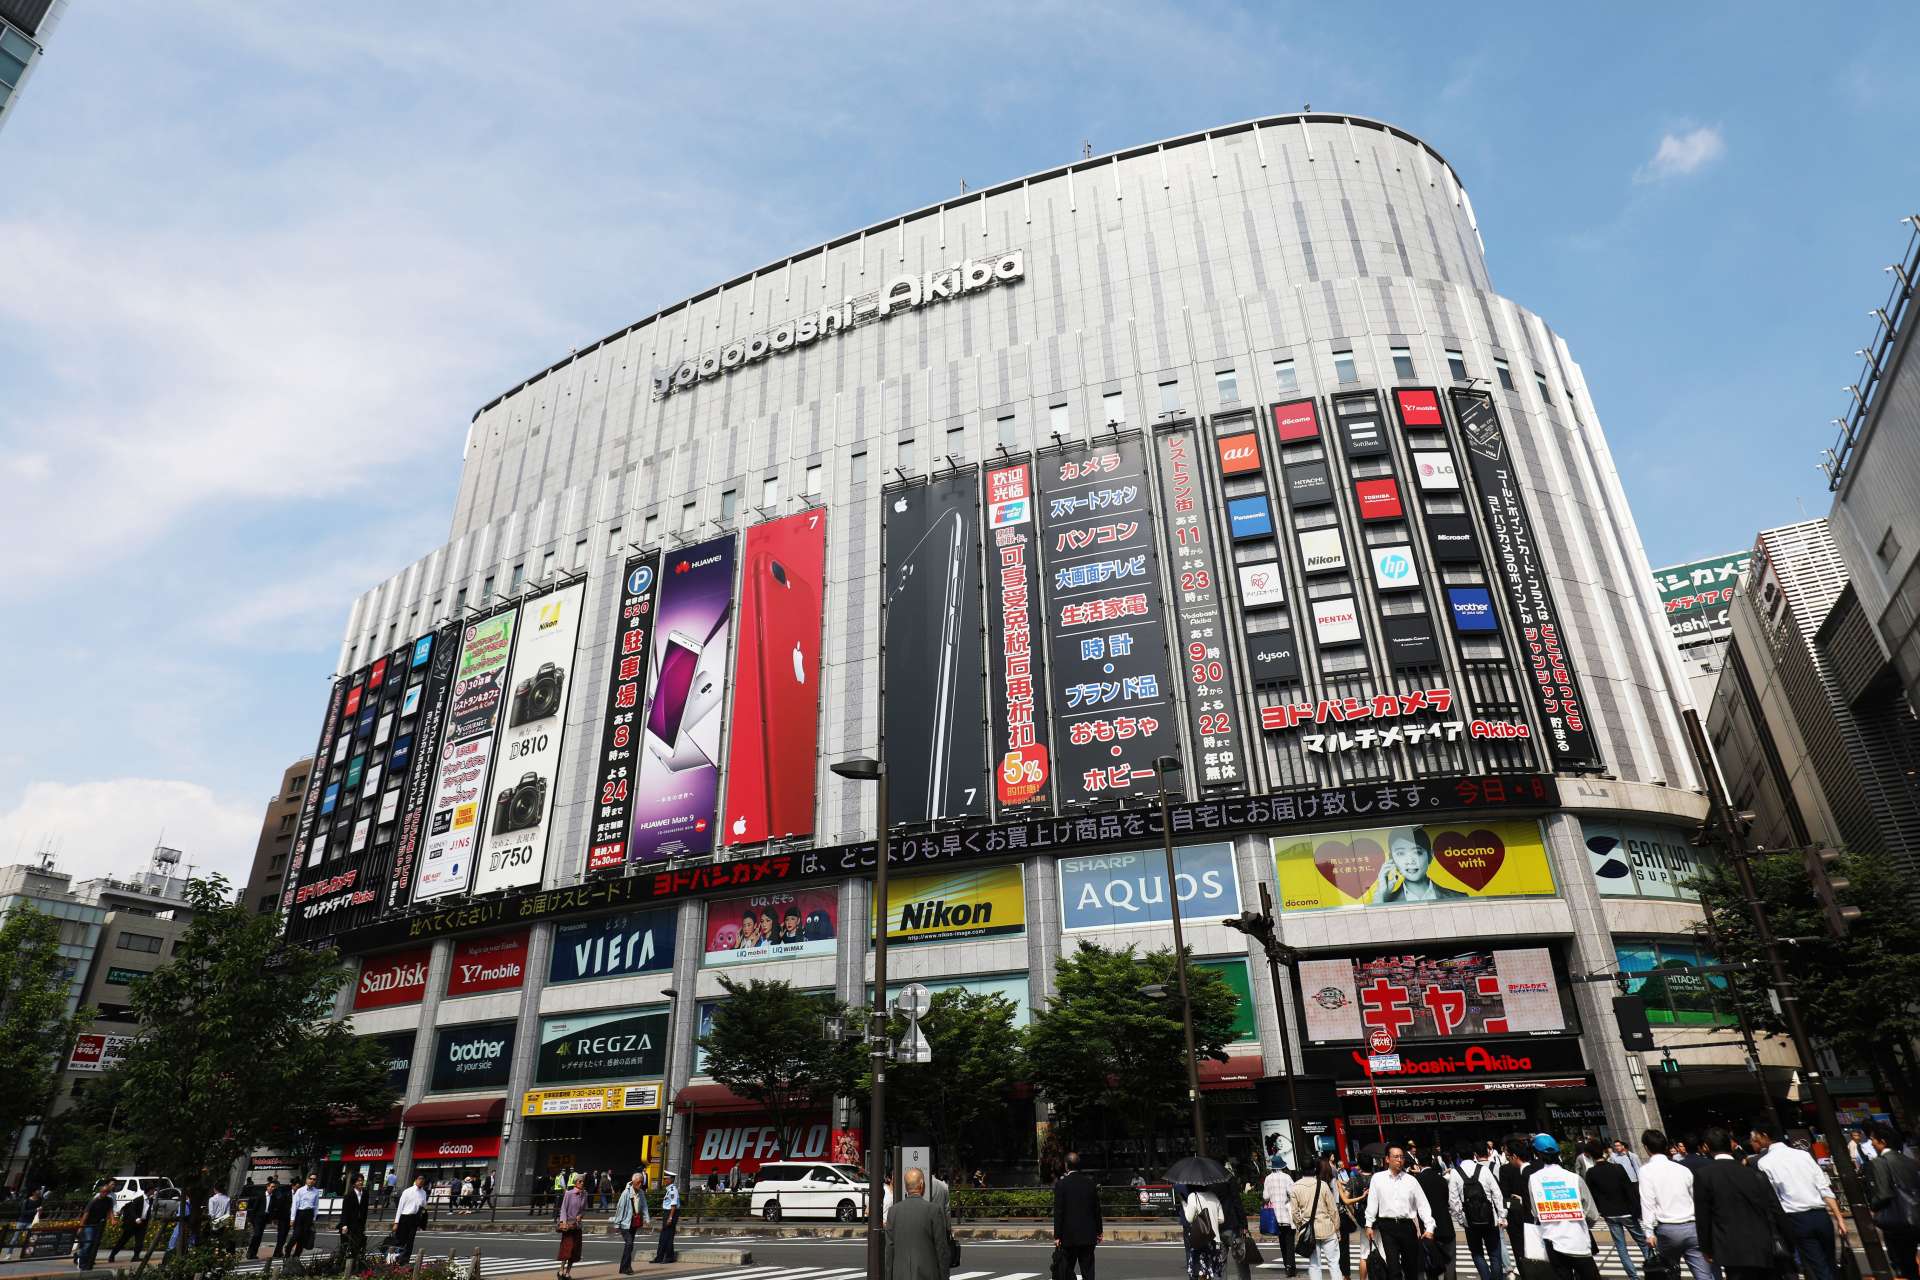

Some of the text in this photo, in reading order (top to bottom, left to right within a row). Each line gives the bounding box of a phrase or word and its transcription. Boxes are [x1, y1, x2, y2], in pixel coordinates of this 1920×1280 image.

[654, 249, 1023, 396] Yodobashi-Akiba
[1282, 416, 1311, 426] docomo
[1352, 440, 1379, 448] SoftBank
[1224, 447, 1254, 460] au
[1059, 453, 1121, 481] カメラ
[1168, 437, 1193, 512] レストラン街
[1438, 466, 1454, 474] LG
[992, 468, 1022, 485] 欢迎
[1294, 477, 1323, 486] HITACHI
[993, 484, 1024, 501] 光临
[1050, 486, 1137, 519] スマートフォン
[809, 516, 819, 530] 7
[1175, 515, 1197, 526] あさ
[1234, 512, 1266, 521] Panasonic
[1056, 522, 1139, 552] パソコン
[1176, 526, 1201, 545] 11
[1437, 534, 1471, 542] Microsoft
[691, 554, 722, 569] HUAWEI
[1182, 559, 1204, 570] よる
[1307, 555, 1341, 566] Nikon
[1384, 556, 1405, 579] hp
[1054, 555, 1146, 590] 大画面テレビ
[1181, 570, 1210, 591] 23
[624, 602, 649, 618] 520
[1061, 593, 1148, 627] 生活家電
[1181, 610, 1218, 620] Yodobashi
[1454, 603, 1488, 612] brother
[1190, 617, 1212, 625] Akiba
[1318, 614, 1353, 625] PENTAX
[1190, 628, 1214, 639] あさ
[1000, 544, 1036, 750] 可享受免税后再折扣
[1081, 633, 1133, 661] 時計
[1188, 642, 1220, 662] 9時
[1257, 650, 1290, 663] dyson
[615, 629, 644, 708] 駐車場
[1192, 662, 1224, 684] 30
[1065, 675, 1159, 709] ブランド品
[1200, 700, 1224, 711] よる
[1260, 689, 1452, 730] ヨドバシカメラ
[614, 712, 634, 726] あさ
[1199, 712, 1231, 736] 22
[614, 725, 630, 748] 8
[1070, 715, 1159, 747] おもちゃ
[1303, 719, 1529, 753] マルチメディア Akiba
[510, 734, 548, 760] D810
[1204, 751, 1234, 765] 年中
[607, 767, 627, 780] よる
[1003, 751, 1043, 785] 5%
[1206, 765, 1236, 780] 無休
[1083, 763, 1155, 793] ホビー
[601, 779, 627, 804] 24
[964, 788, 977, 806] 7
[640, 819, 670, 830] HUAWEI
[671, 816, 688, 826] Mate
[450, 837, 470, 850] JINS
[1444, 846, 1495, 858] docomo
[489, 845, 533, 871] D750
[1065, 856, 1136, 873] SHARP
[1458, 857, 1486, 869] with
[653, 858, 792, 896] ヨドバシカメラ
[296, 870, 357, 903] ヨドバシカメラ
[1077, 870, 1223, 912] AQUOS
[1285, 898, 1319, 907] docomo
[900, 900, 992, 931] Nikon
[575, 929, 655, 976] VIERA
[736, 949, 768, 958] UQ mobile
[772, 946, 783, 954] UQ
[360, 962, 429, 994] SanDisk
[460, 963, 521, 984] Y!mobile
[450, 1039, 505, 1062] brother
[577, 1034, 652, 1056] REGZA
[456, 1060, 492, 1074] at your side
[354, 1145, 384, 1158] docomo
[438, 1143, 473, 1155] docomo
